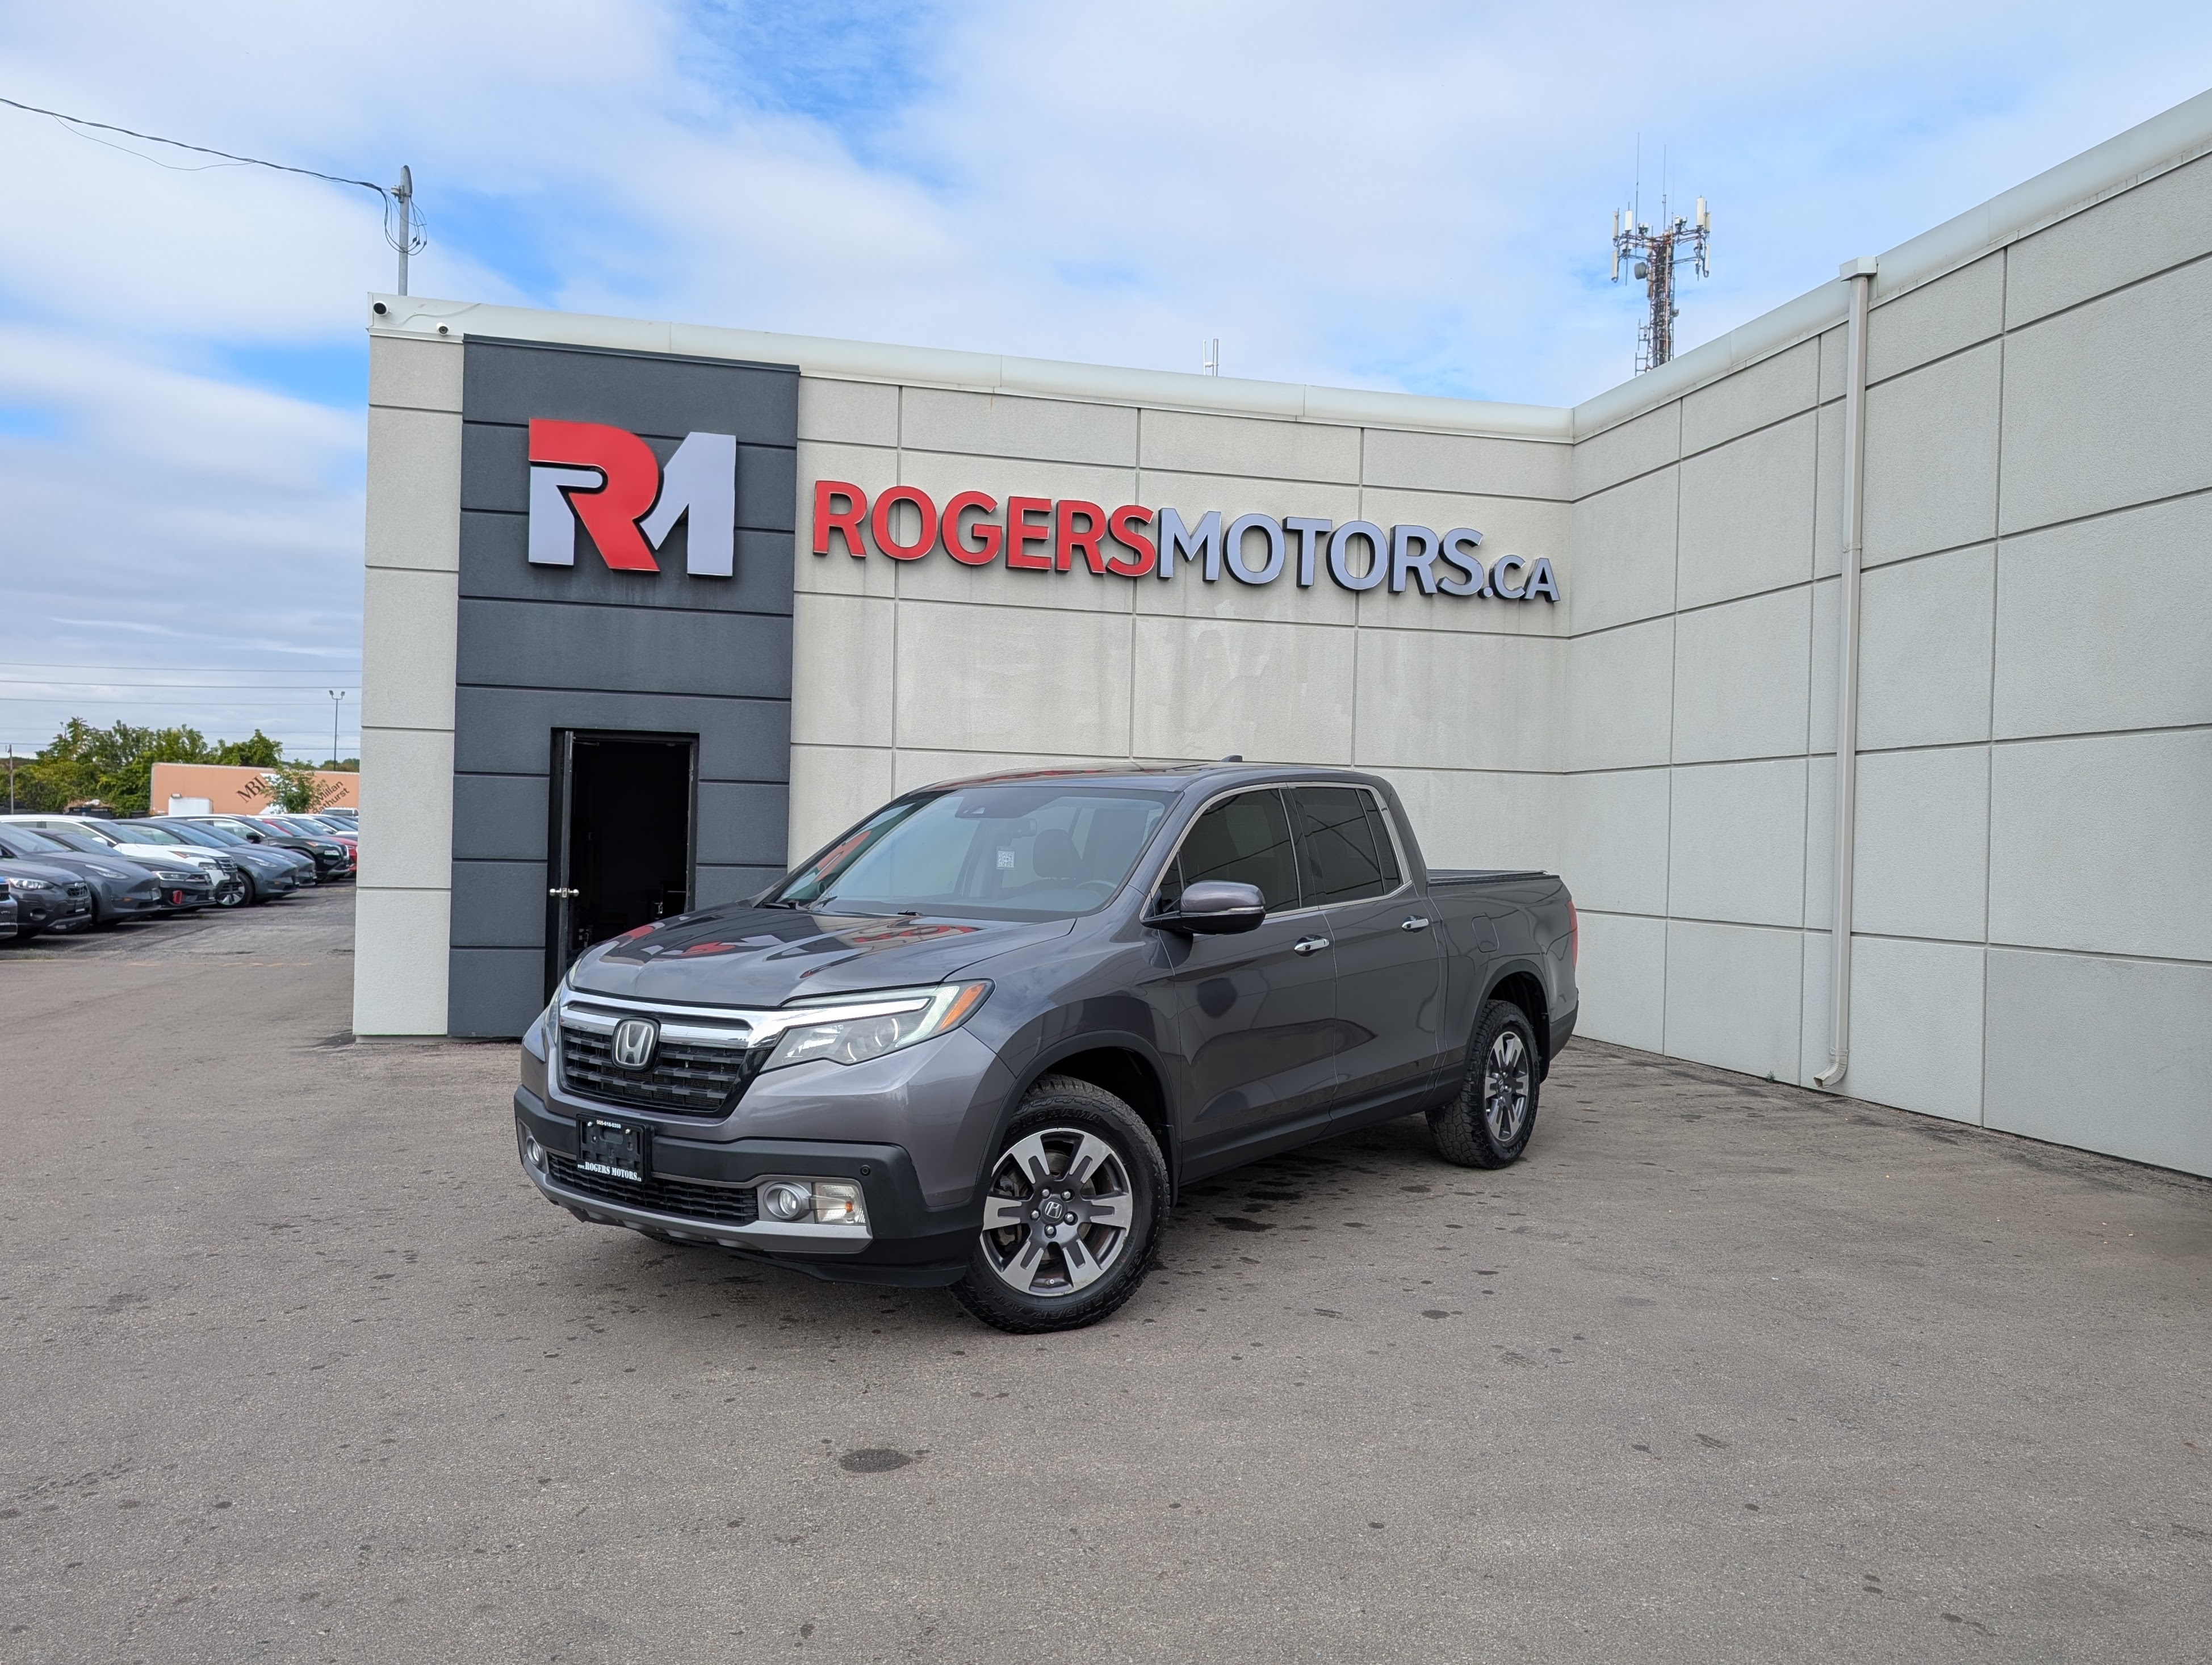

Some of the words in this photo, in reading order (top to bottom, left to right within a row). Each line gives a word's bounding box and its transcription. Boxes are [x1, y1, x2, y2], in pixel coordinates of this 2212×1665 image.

[529, 418, 736, 578] RM
[236, 775, 266, 804] MBI
[1009, 1108, 1103, 1134] OKOHAMA
